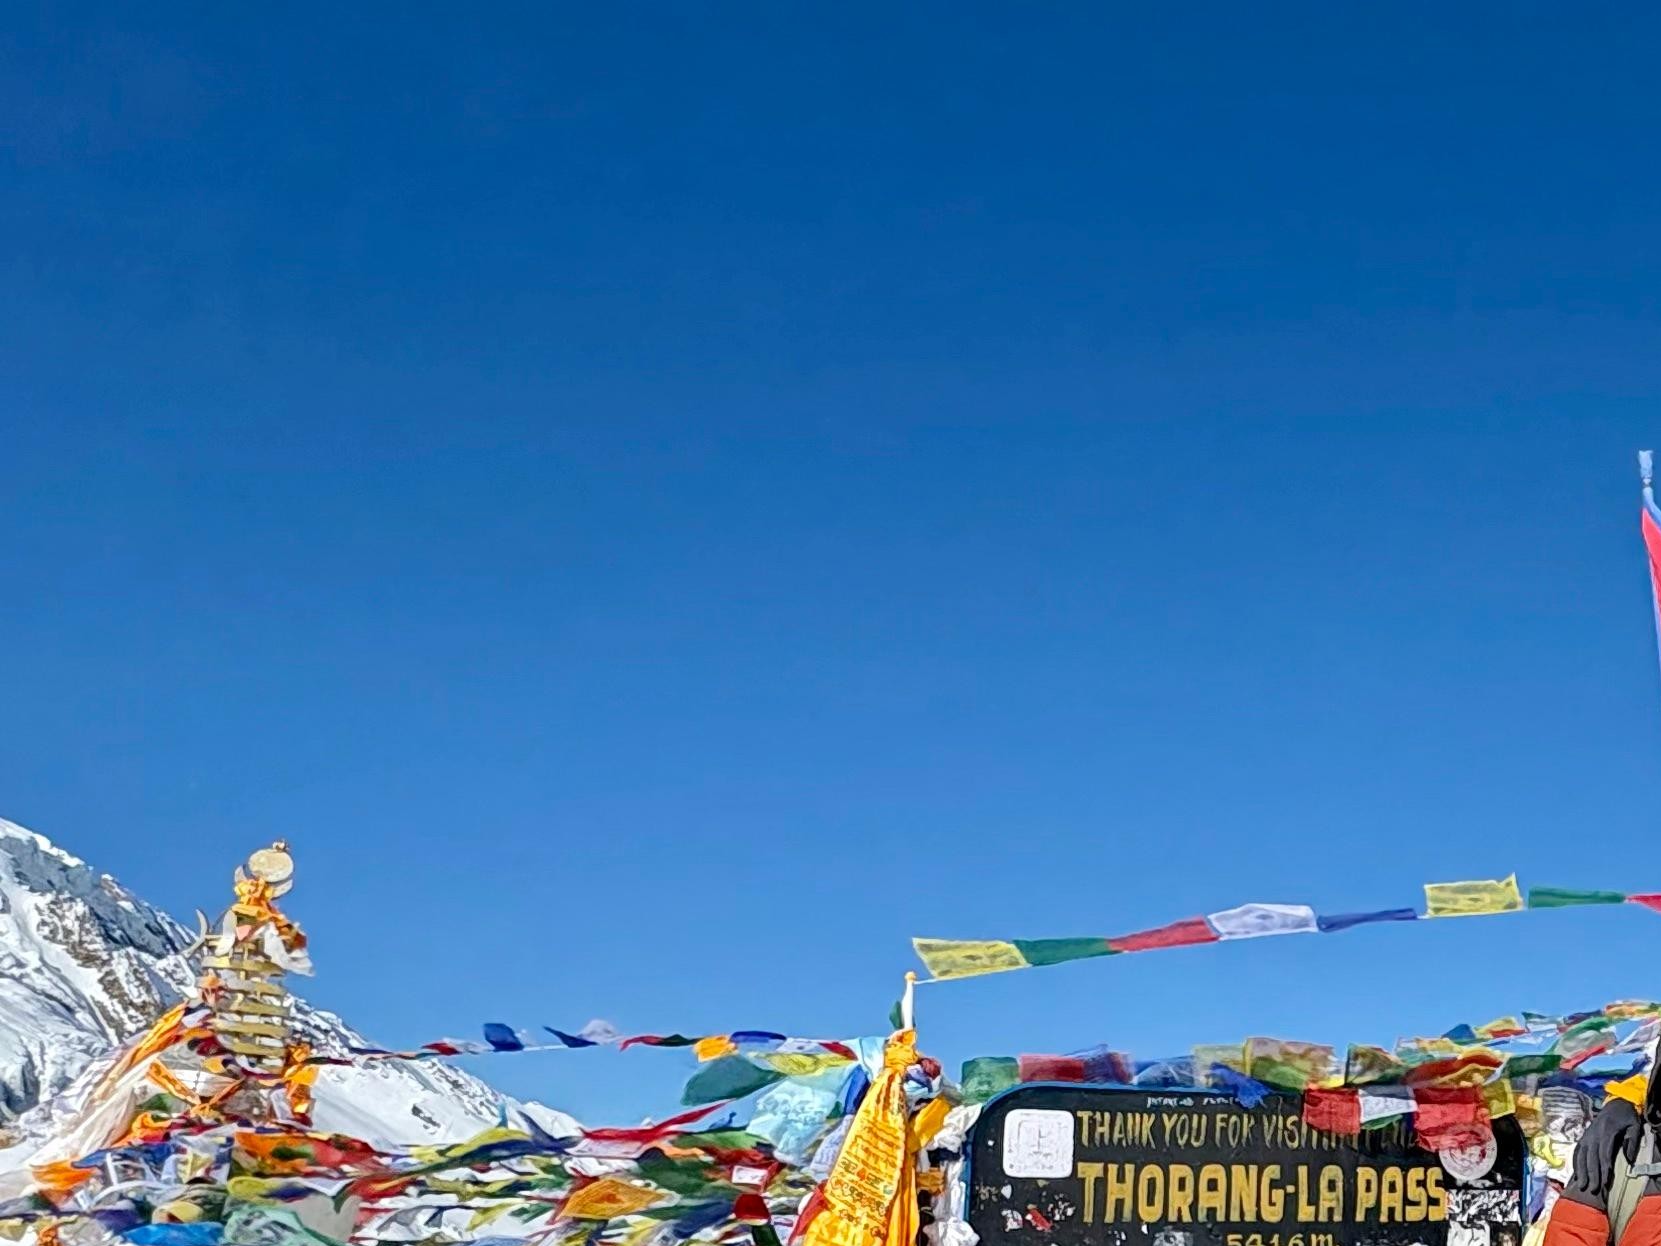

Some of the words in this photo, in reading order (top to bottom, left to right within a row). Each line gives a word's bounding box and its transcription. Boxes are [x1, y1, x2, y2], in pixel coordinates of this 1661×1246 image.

[1077, 1110, 1156, 1149] THANK
[1162, 1112, 1208, 1149] YOU
[1215, 1112, 1255, 1149] FOR
[1077, 1161, 1344, 1224] THORANG-LA
[1355, 1165, 1448, 1223] PASS
